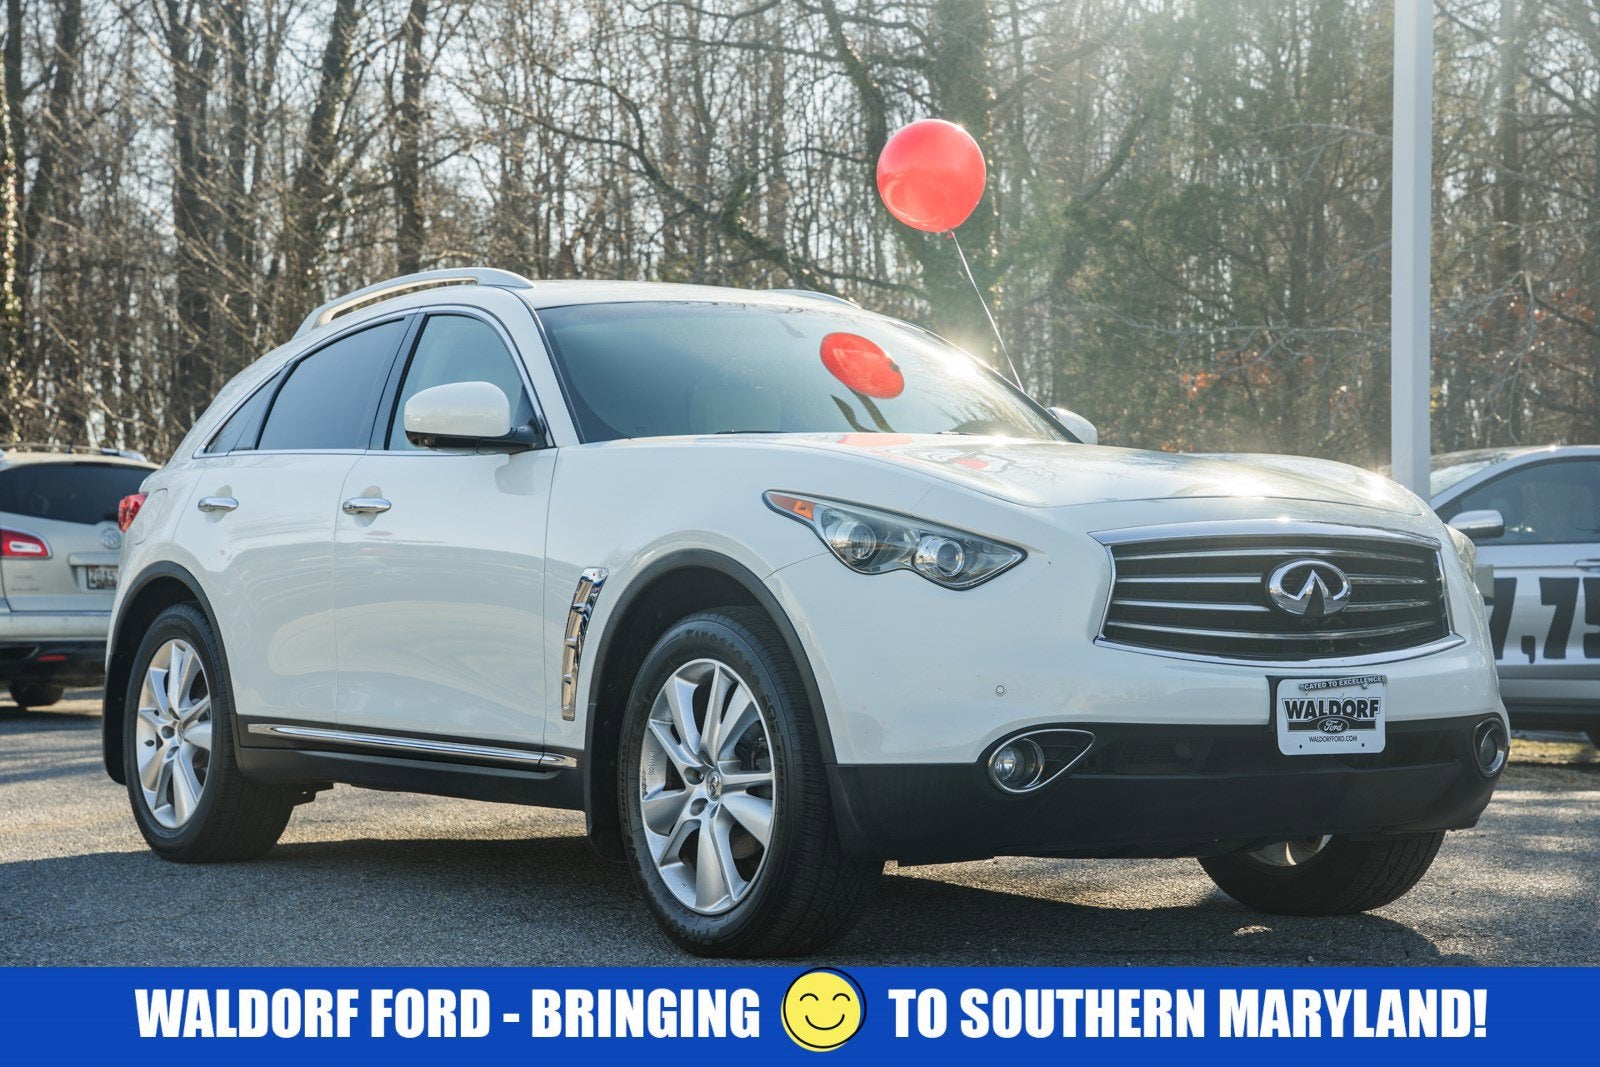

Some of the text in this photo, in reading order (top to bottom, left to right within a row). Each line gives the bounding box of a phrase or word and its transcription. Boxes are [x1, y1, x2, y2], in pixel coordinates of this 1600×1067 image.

[1339, 676, 1382, 686] EXCELLENCE
[1283, 698, 1380, 719] WALDORF
[1323, 719, 1344, 731] Ford
[1308, 734, 1358, 743] WALDORFFORD.COM
